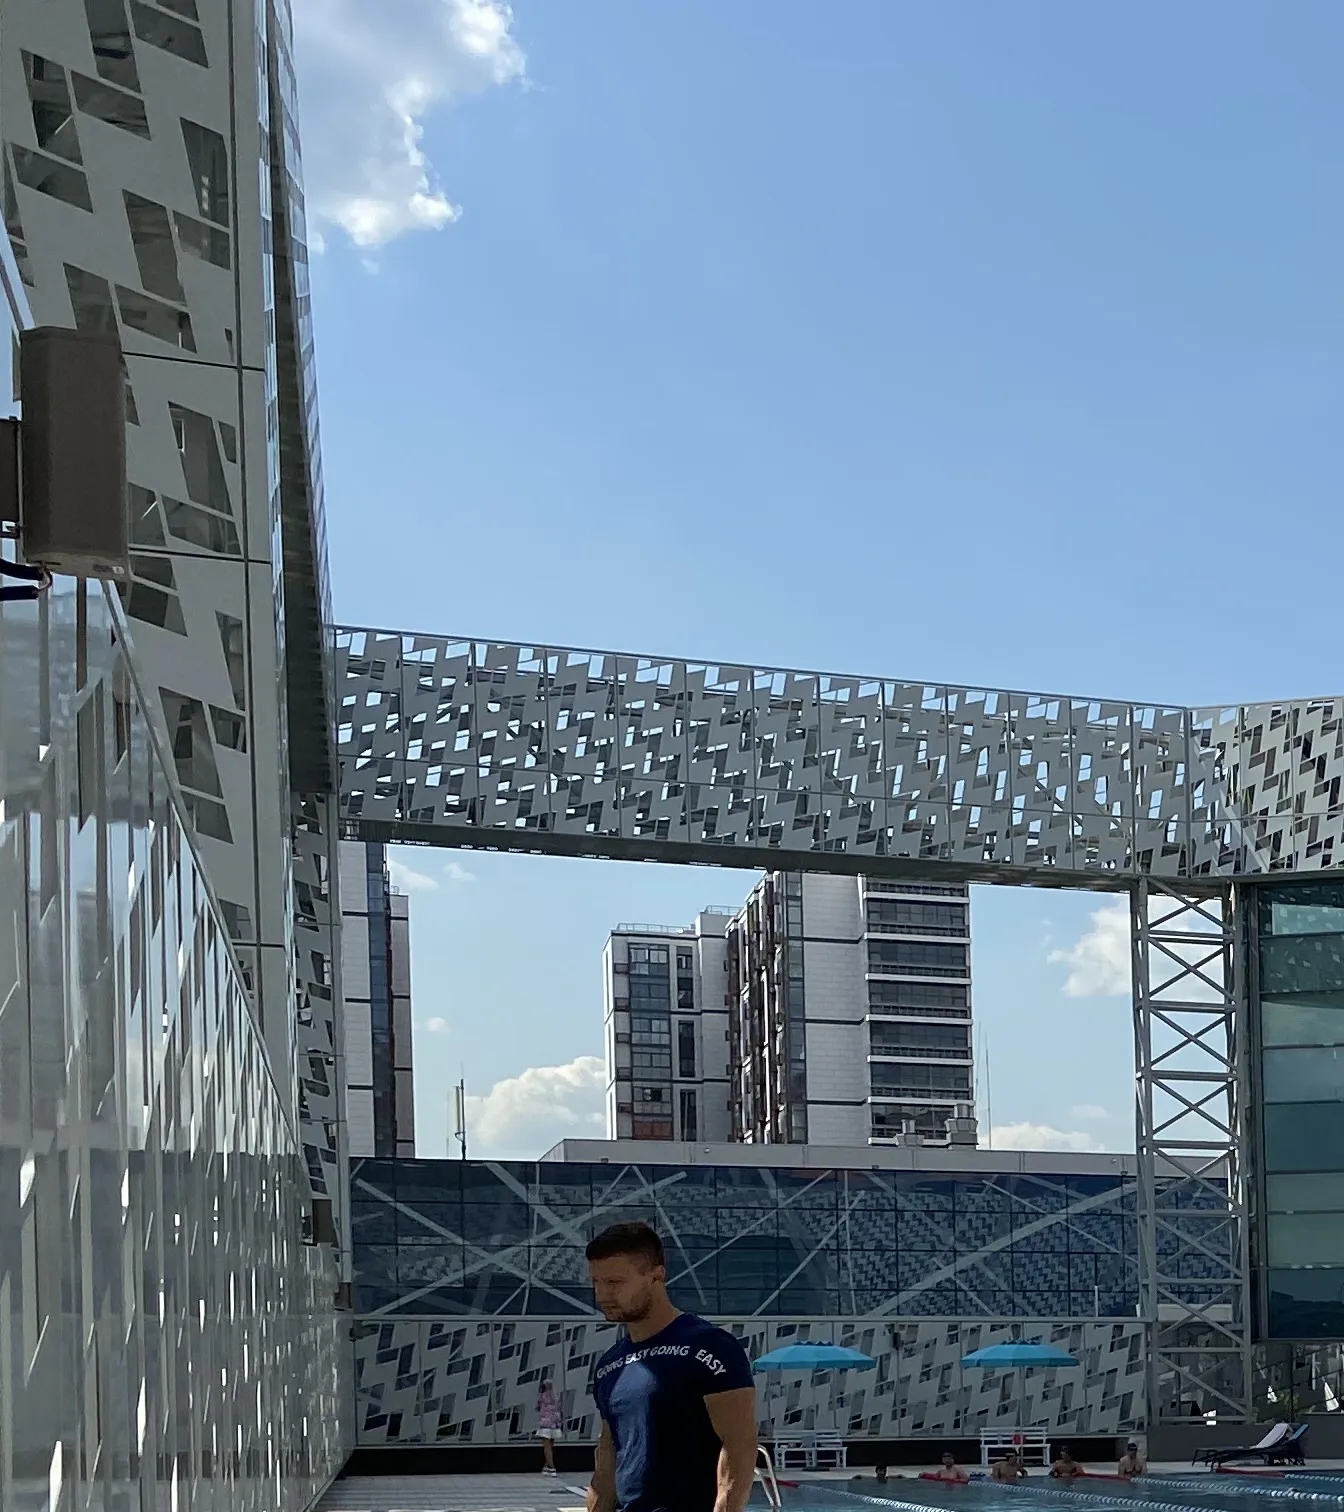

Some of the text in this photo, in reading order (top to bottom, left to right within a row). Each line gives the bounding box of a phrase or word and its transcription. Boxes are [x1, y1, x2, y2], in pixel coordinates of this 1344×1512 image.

[597, 1345, 727, 1379] GOING EASY GOING EASY
